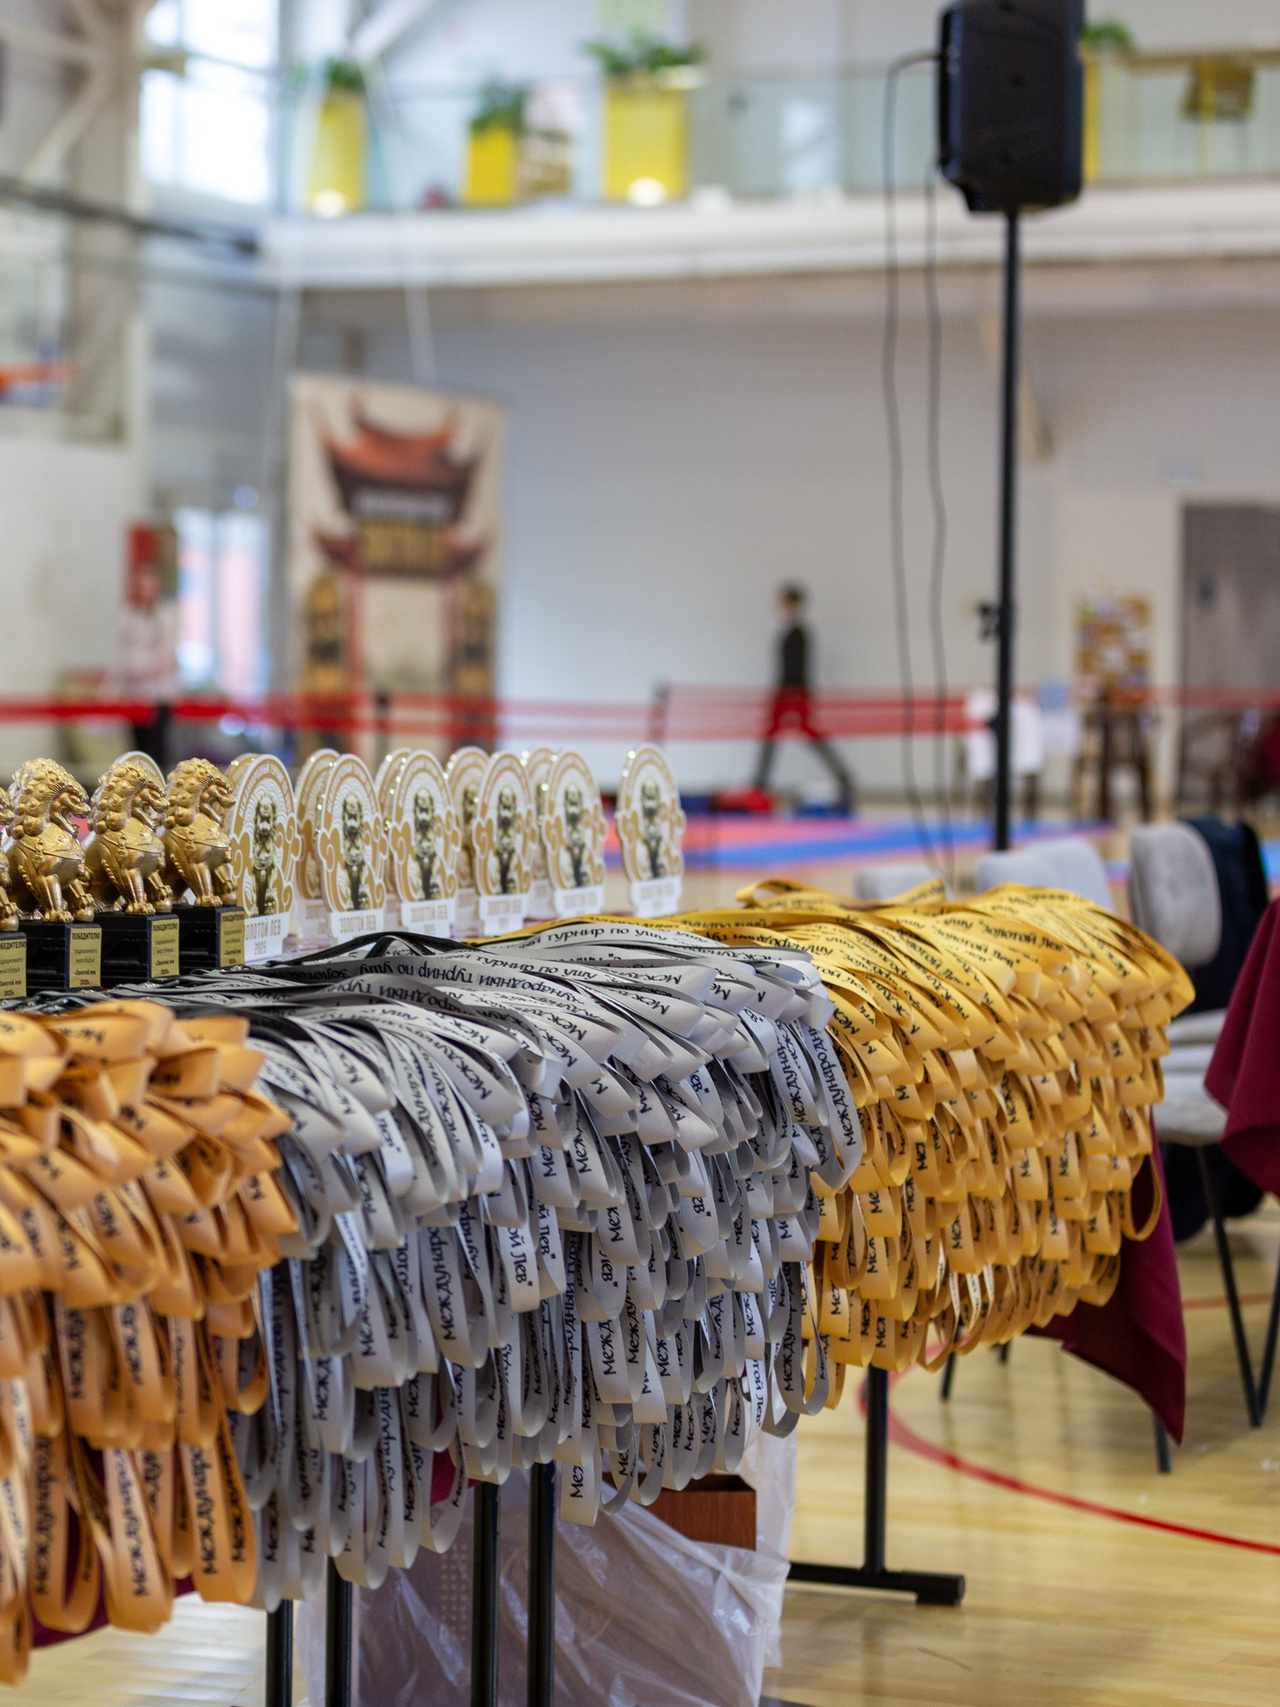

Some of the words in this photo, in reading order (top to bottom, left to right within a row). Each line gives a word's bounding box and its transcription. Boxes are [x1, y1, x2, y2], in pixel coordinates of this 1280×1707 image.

[71, 931, 100, 942] ПОБЕДИТЕЛЮ
[547, 926, 604, 943] турнир
[609, 927, 630, 936] по
[634, 929, 667, 942] ушу
[360, 961, 393, 978] ушу
[398, 963, 415, 974] по
[420, 961, 473, 984] турнир
[477, 955, 534, 973] турнир
[539, 965, 559, 974] по
[560, 967, 597, 980] ушу
